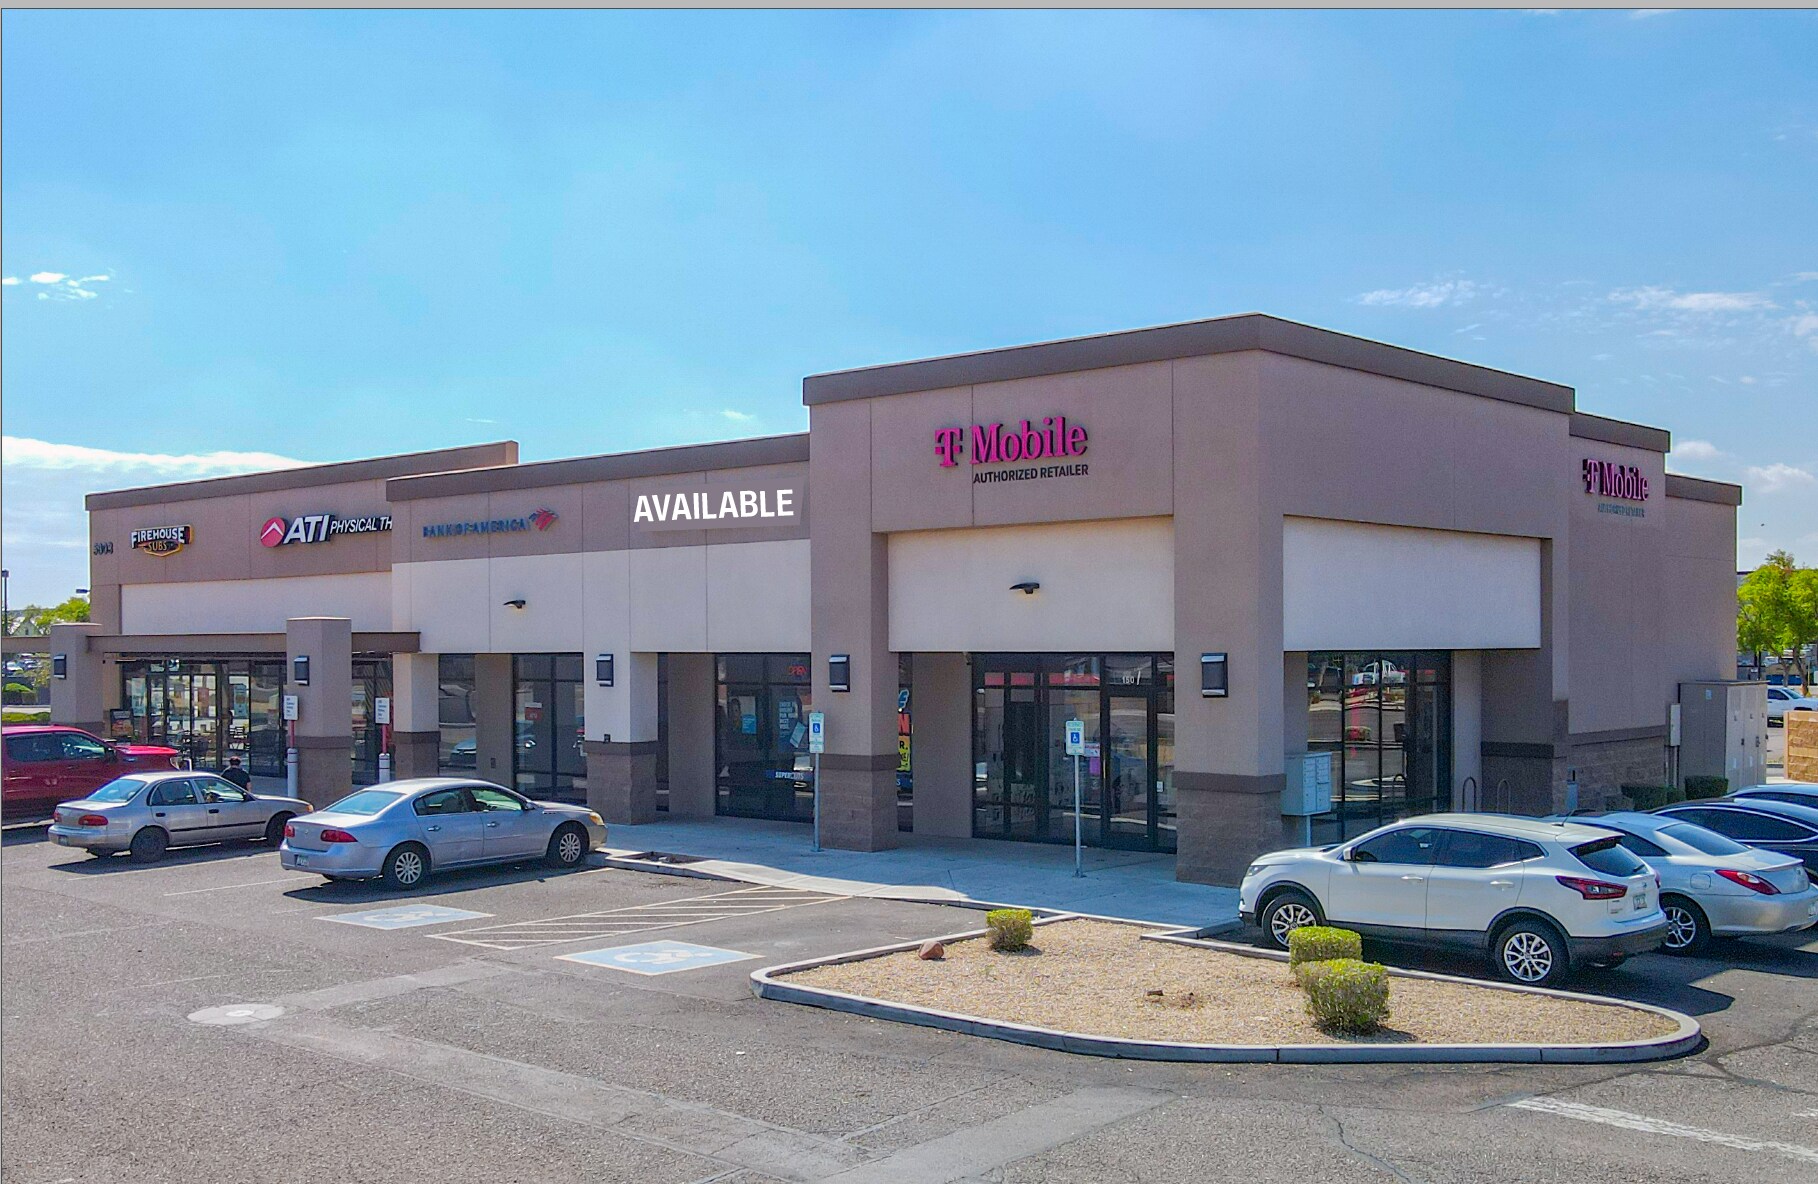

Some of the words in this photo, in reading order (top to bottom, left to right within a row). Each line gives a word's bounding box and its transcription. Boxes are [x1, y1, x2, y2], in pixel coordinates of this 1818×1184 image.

[969, 416, 1088, 465] Mobile
[973, 467, 1038, 484] AUTHORIZED
[1040, 464, 1089, 479] RETAILER
[1600, 461, 1649, 501] Mobile
[131, 526, 185, 549] FIREHOUSE
[283, 514, 331, 545] ATI
[330, 518, 378, 535] PHYSICAL
[422, 523, 453, 538] BANK
[472, 518, 527, 535] AMERICA
[148, 540, 168, 552] SUBS
